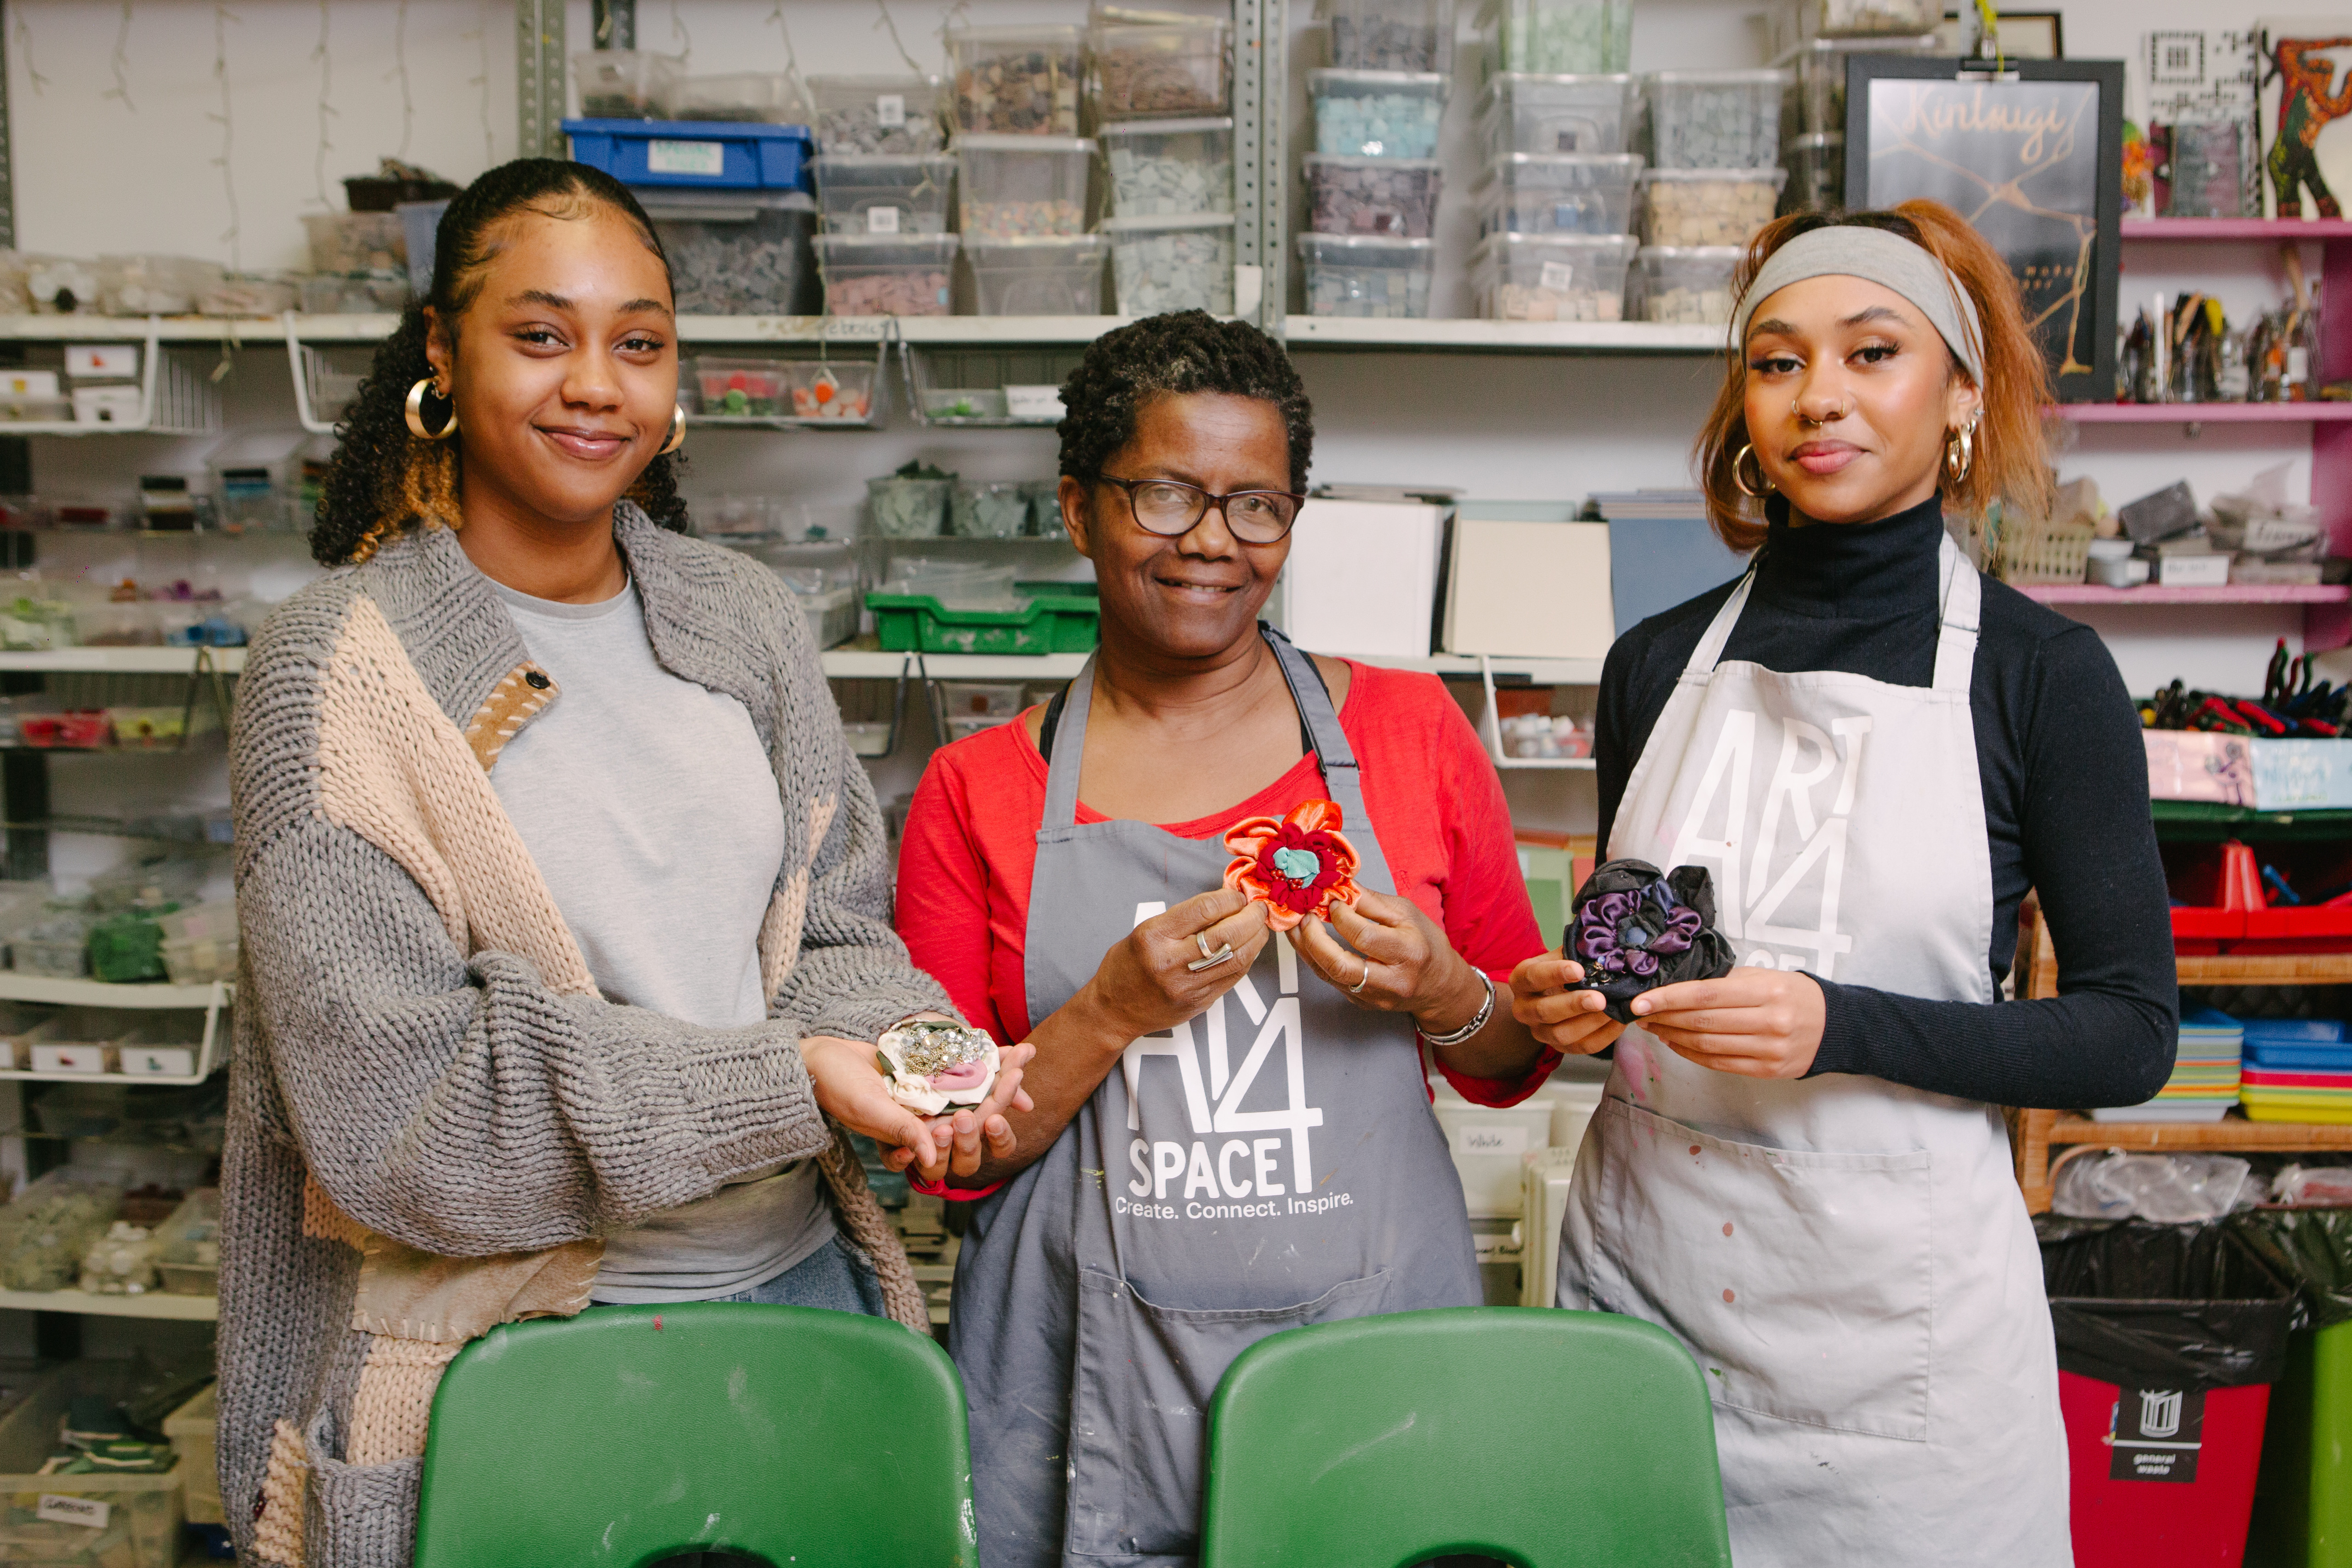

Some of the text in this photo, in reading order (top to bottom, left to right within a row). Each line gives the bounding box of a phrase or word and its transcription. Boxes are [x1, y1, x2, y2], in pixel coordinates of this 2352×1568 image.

[1665, 709, 1873, 939] ART
[1214, 997, 1323, 1194] 4
[1128, 1138, 1285, 1199] SPACE
[1116, 1192, 1353, 1219] Create. Connect. Inspire.
[2133, 1454, 2176, 1465] general
[2136, 1465, 2170, 1475] waste
